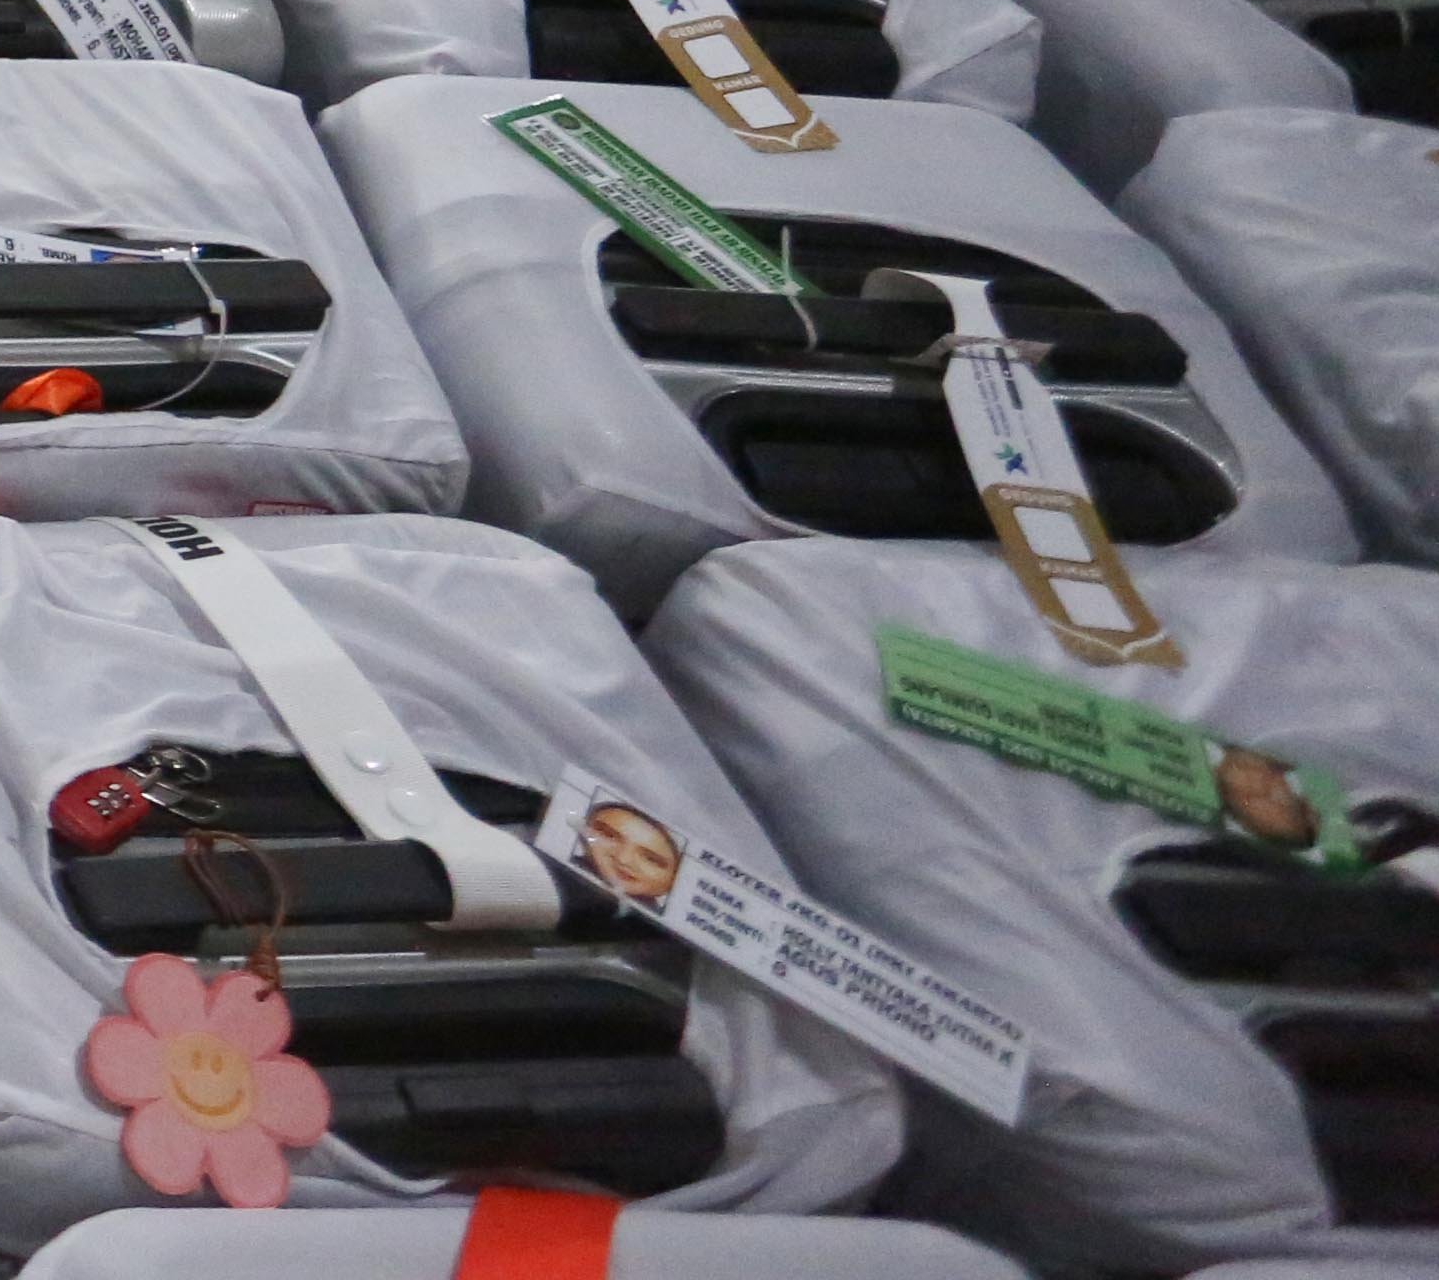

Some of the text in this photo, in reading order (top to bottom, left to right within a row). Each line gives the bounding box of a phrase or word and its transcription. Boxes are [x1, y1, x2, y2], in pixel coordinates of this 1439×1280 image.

[134, 0, 174, 43] JKG-01
[669, 19, 725, 39] GEDUNG
[85, 37, 101, 51] 6
[712, 75, 763, 93] KAMAR
[4, 237, 14, 251] 6
[779, 923, 840, 967] HOLLY
[774, 941, 841, 987] AGUS
